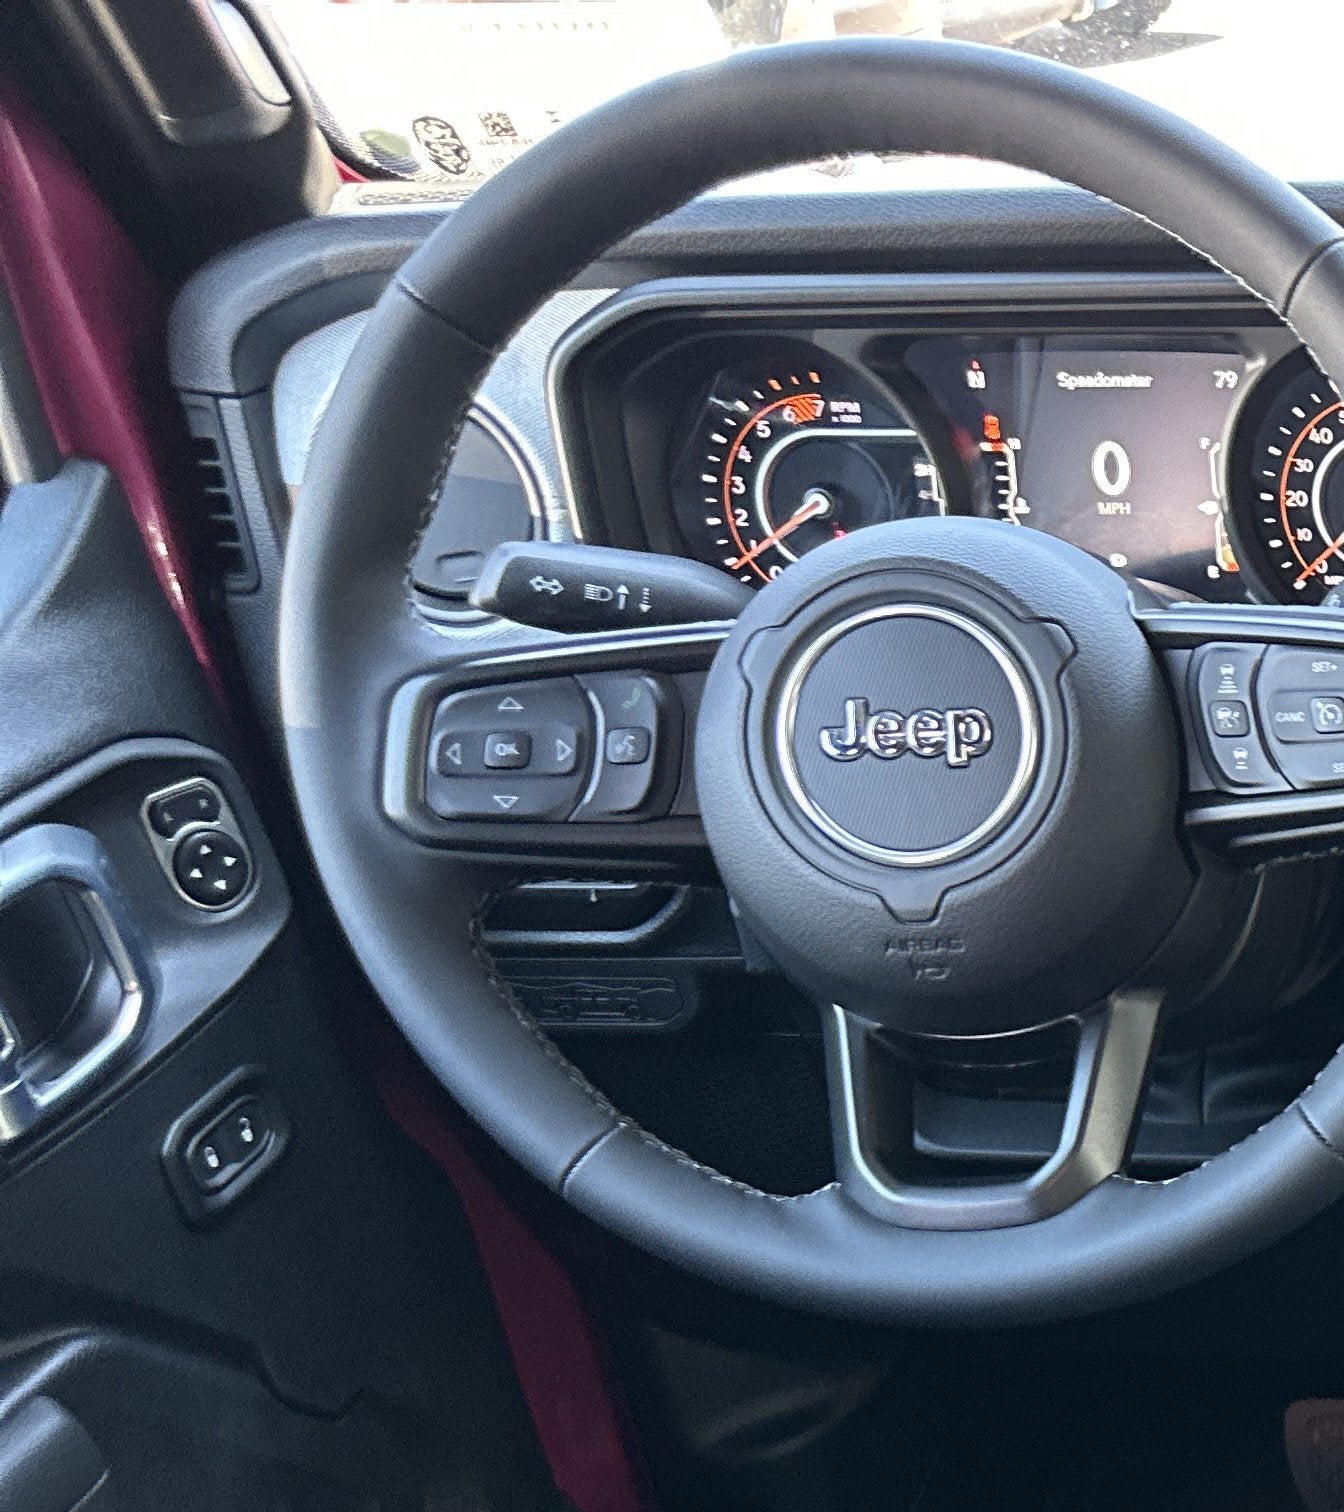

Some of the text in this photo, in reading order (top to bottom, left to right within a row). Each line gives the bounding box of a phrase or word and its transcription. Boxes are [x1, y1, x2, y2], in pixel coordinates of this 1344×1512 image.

[1056, 371, 1153, 391] Speedometer
[1213, 370, 1239, 388] 79
[756, 420, 771, 438] 5
[1309, 427, 1334, 444] 40
[1091, 440, 1132, 496] 0
[1294, 458, 1315, 473] 30
[730, 476, 746, 494] 3
[1285, 490, 1309, 507] 20
[734, 508, 750, 527] 2
[1097, 502, 1131, 515] MPH
[1296, 528, 1313, 542] 10
[820, 697, 994, 768] Jeep
[494, 742, 520, 757] OK
